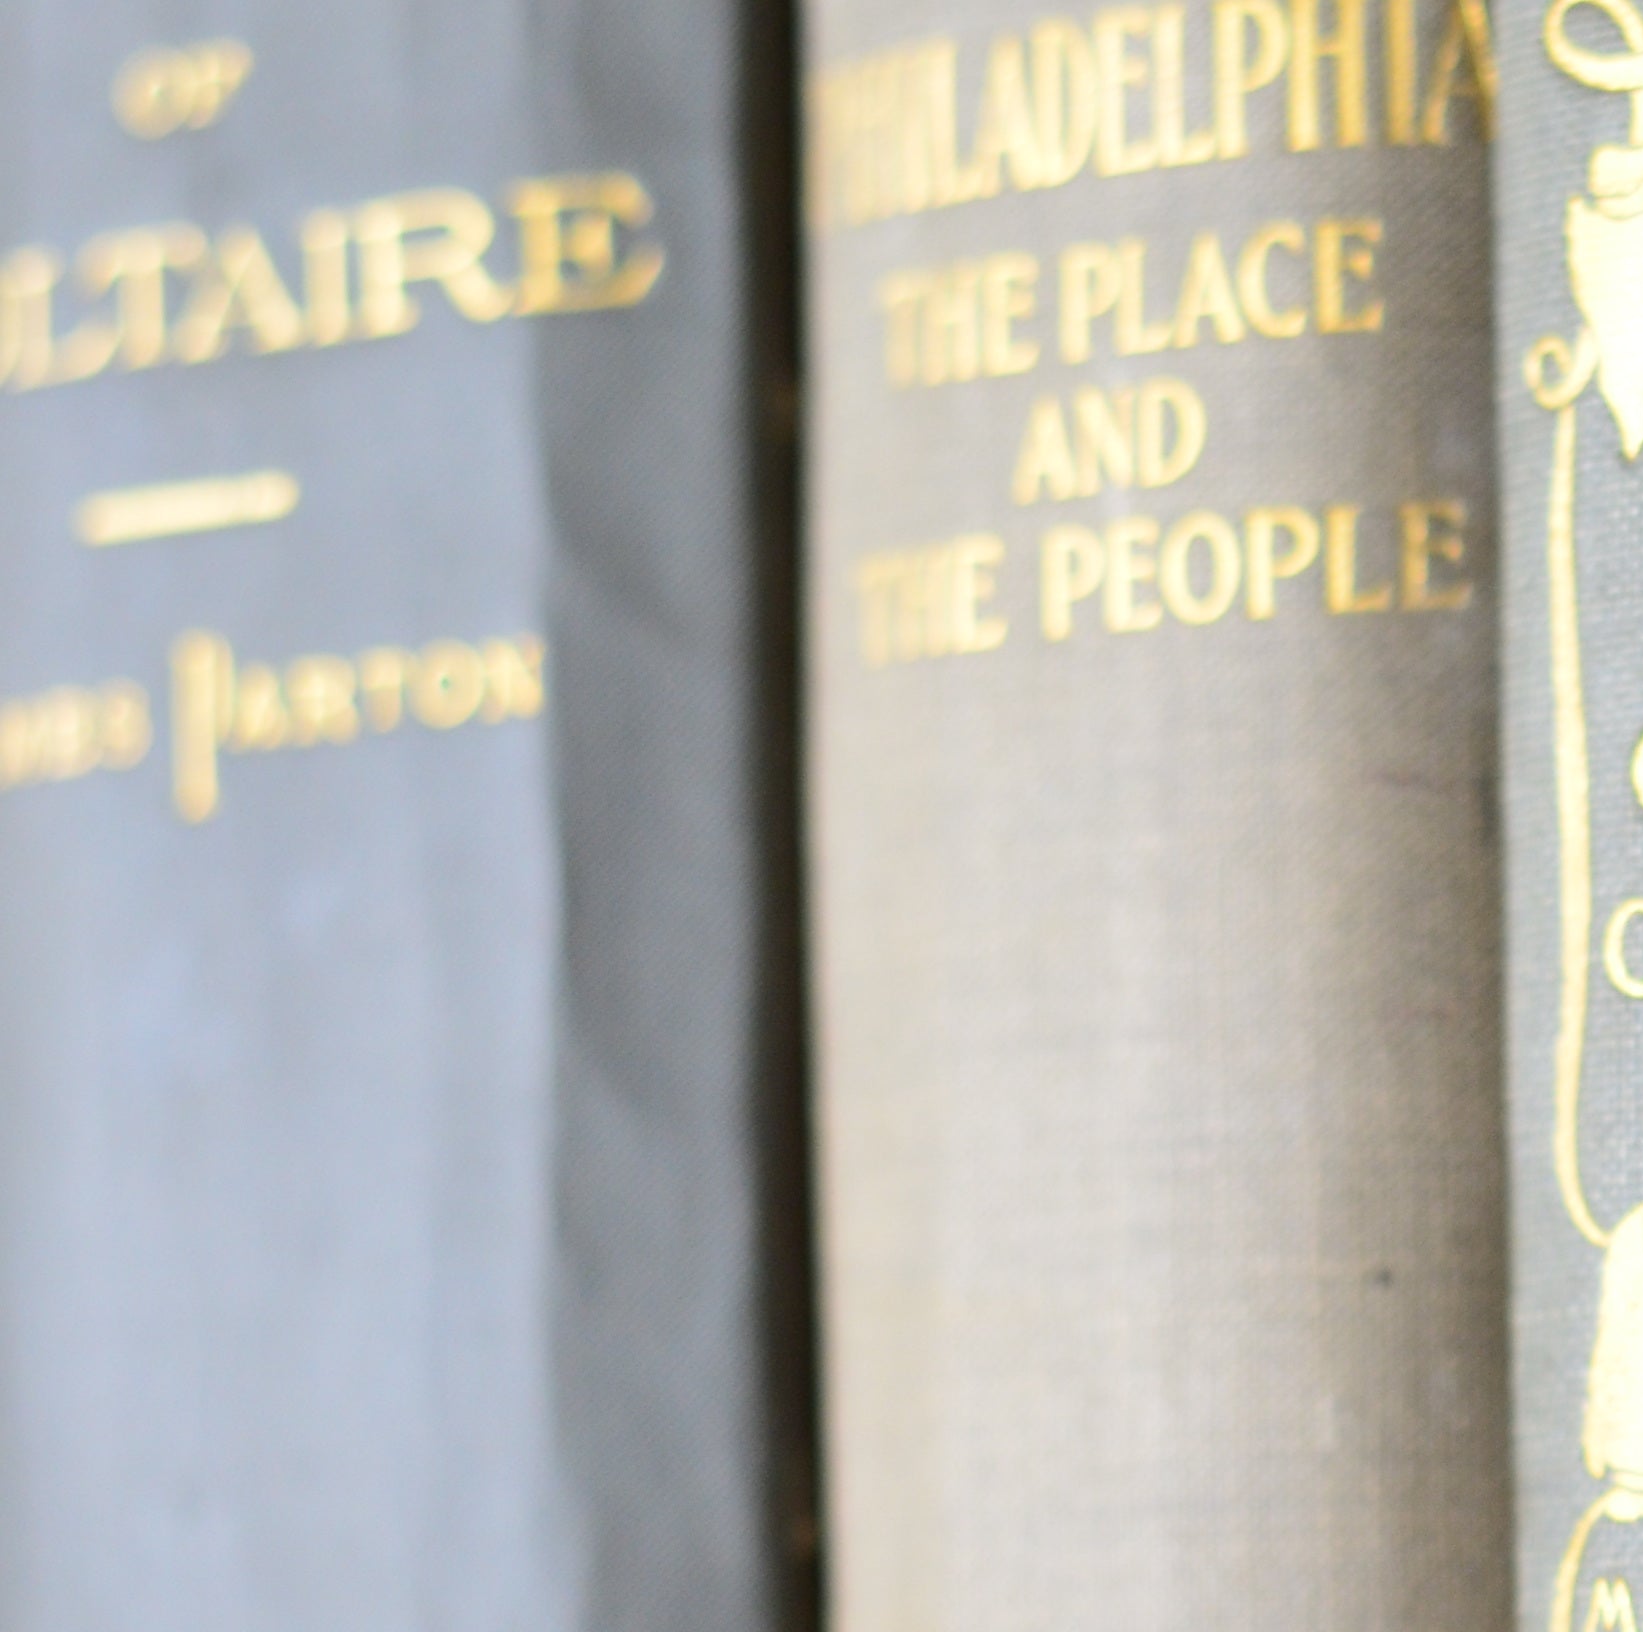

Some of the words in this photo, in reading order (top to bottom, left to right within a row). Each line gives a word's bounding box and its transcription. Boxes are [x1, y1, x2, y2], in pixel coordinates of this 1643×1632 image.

[0, 170, 665, 394] LTAIRE
[878, 249, 1041, 390] THE
[1058, 217, 1385, 367] PLACE
[1010, 376, 1207, 506] AND
[855, 532, 1008, 669] THE
[1039, 498, 1474, 644] PEOPLE
